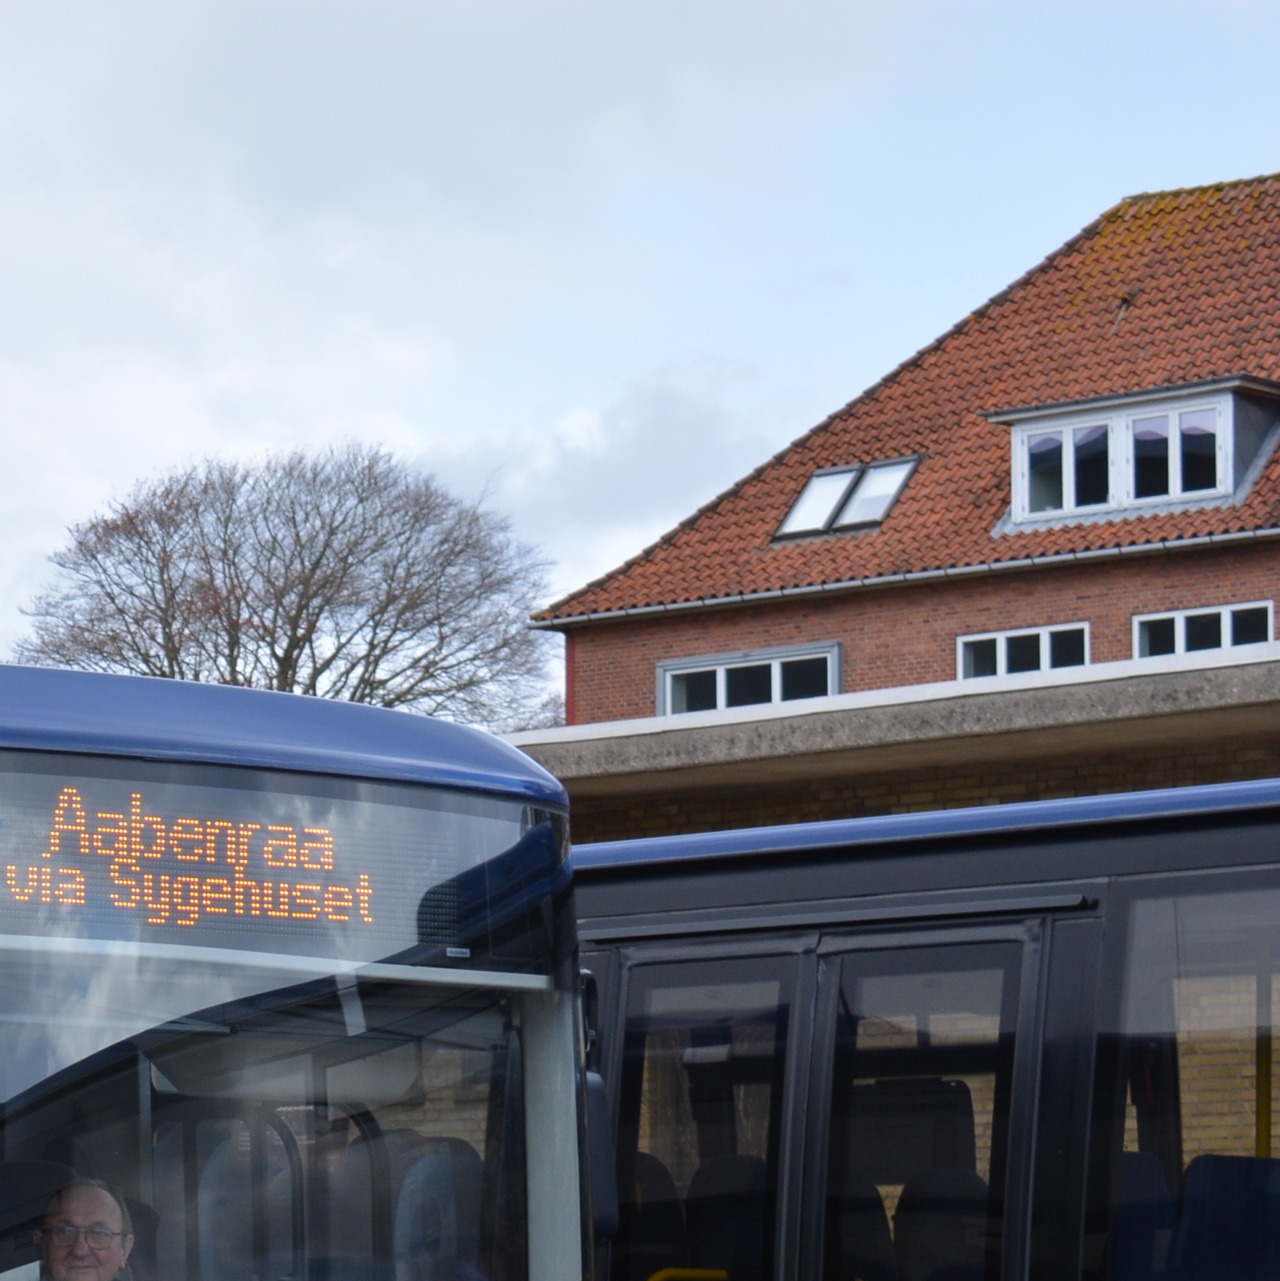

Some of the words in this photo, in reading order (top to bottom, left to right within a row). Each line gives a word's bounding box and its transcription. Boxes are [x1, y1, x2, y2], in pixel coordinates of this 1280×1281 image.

[42, 787, 334, 871] Aabenraa
[6, 864, 86, 905] via
[109, 857, 373, 926] Sygehuset
